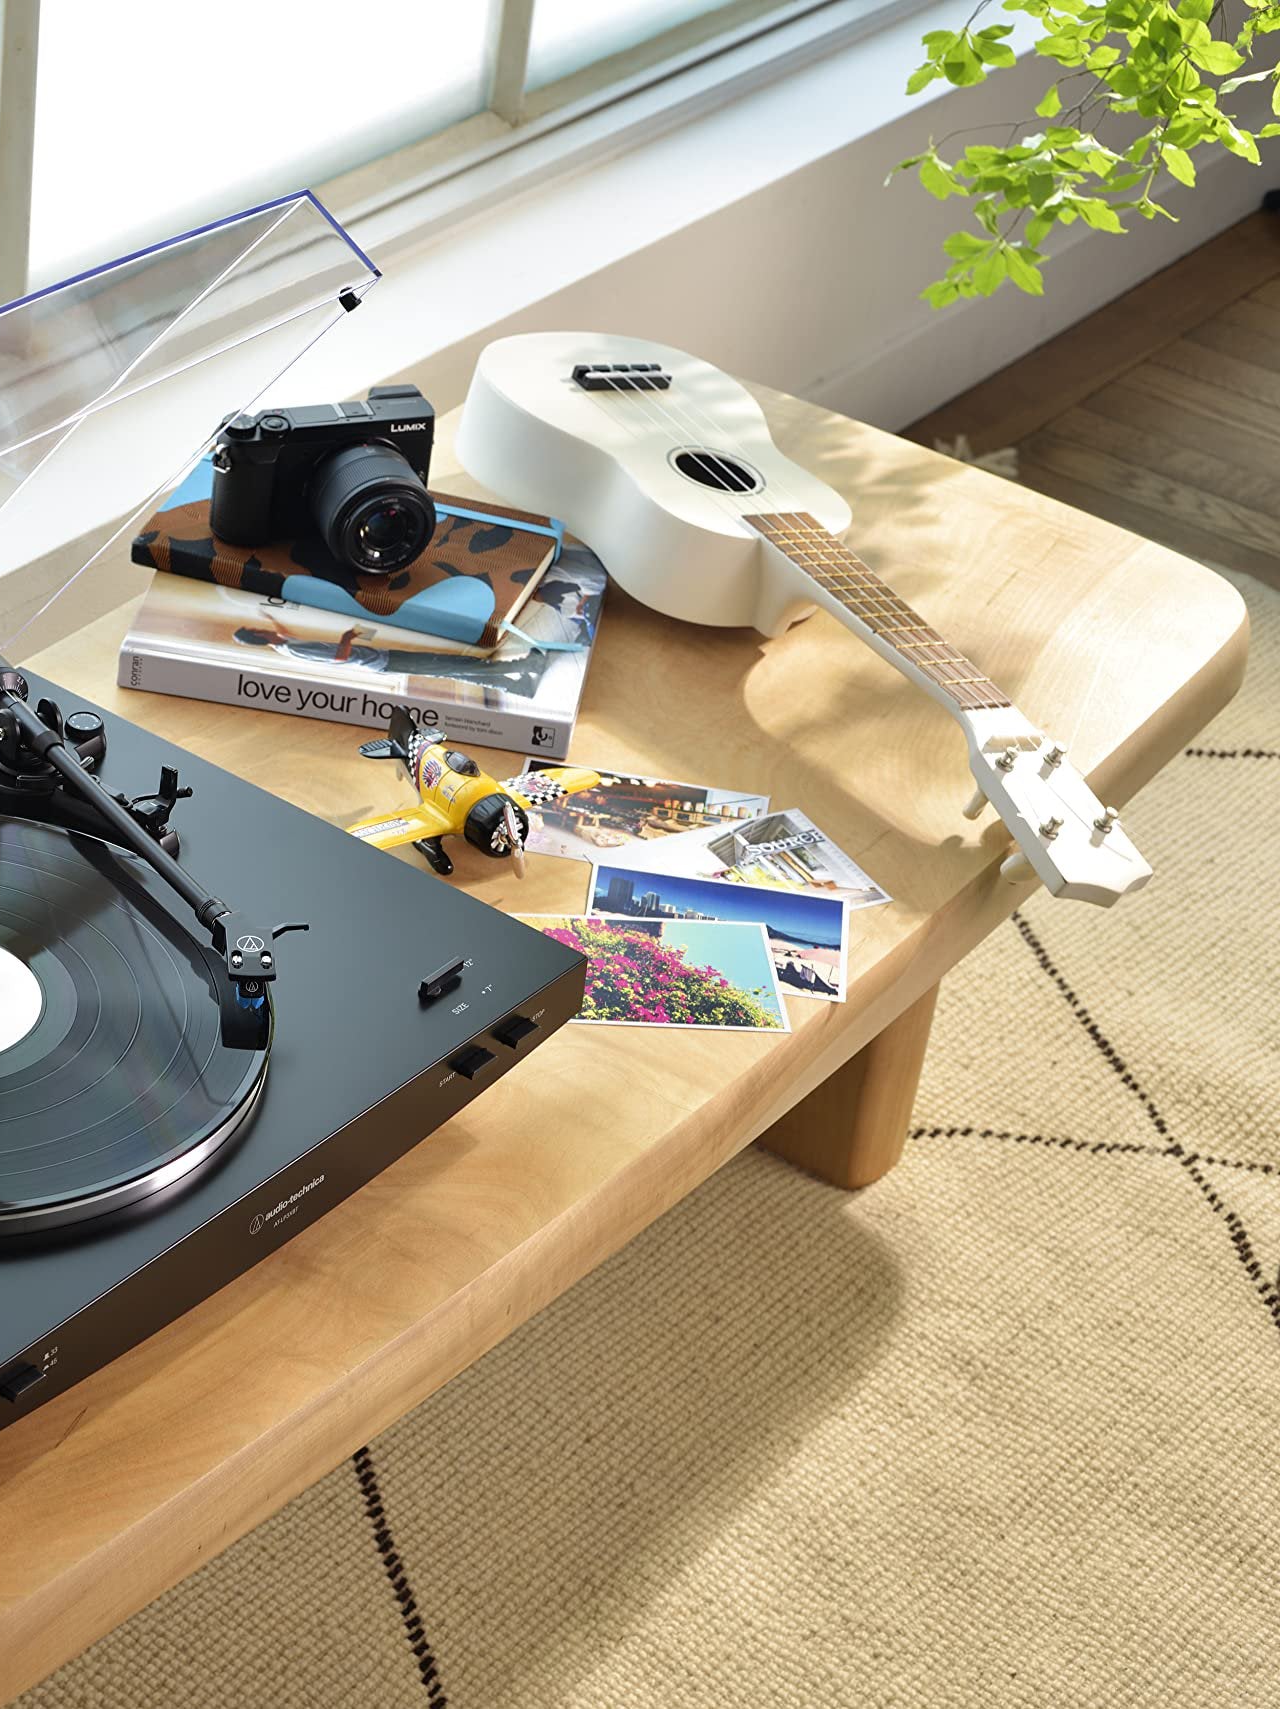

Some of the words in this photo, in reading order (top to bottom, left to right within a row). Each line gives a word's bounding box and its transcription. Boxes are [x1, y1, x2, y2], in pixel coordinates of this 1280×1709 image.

[390, 422, 427, 433] LUMIX
[130, 655, 140, 687] conran
[236, 673, 292, 701] love
[295, 688, 358, 711] your
[746, 830, 825, 854] SOURCE
[451, 1002, 470, 1015] SIZE
[531, 1008, 546, 1022] STOP
[439, 1071, 456, 1088] START
[265, 1174, 325, 1221] audio-technica
